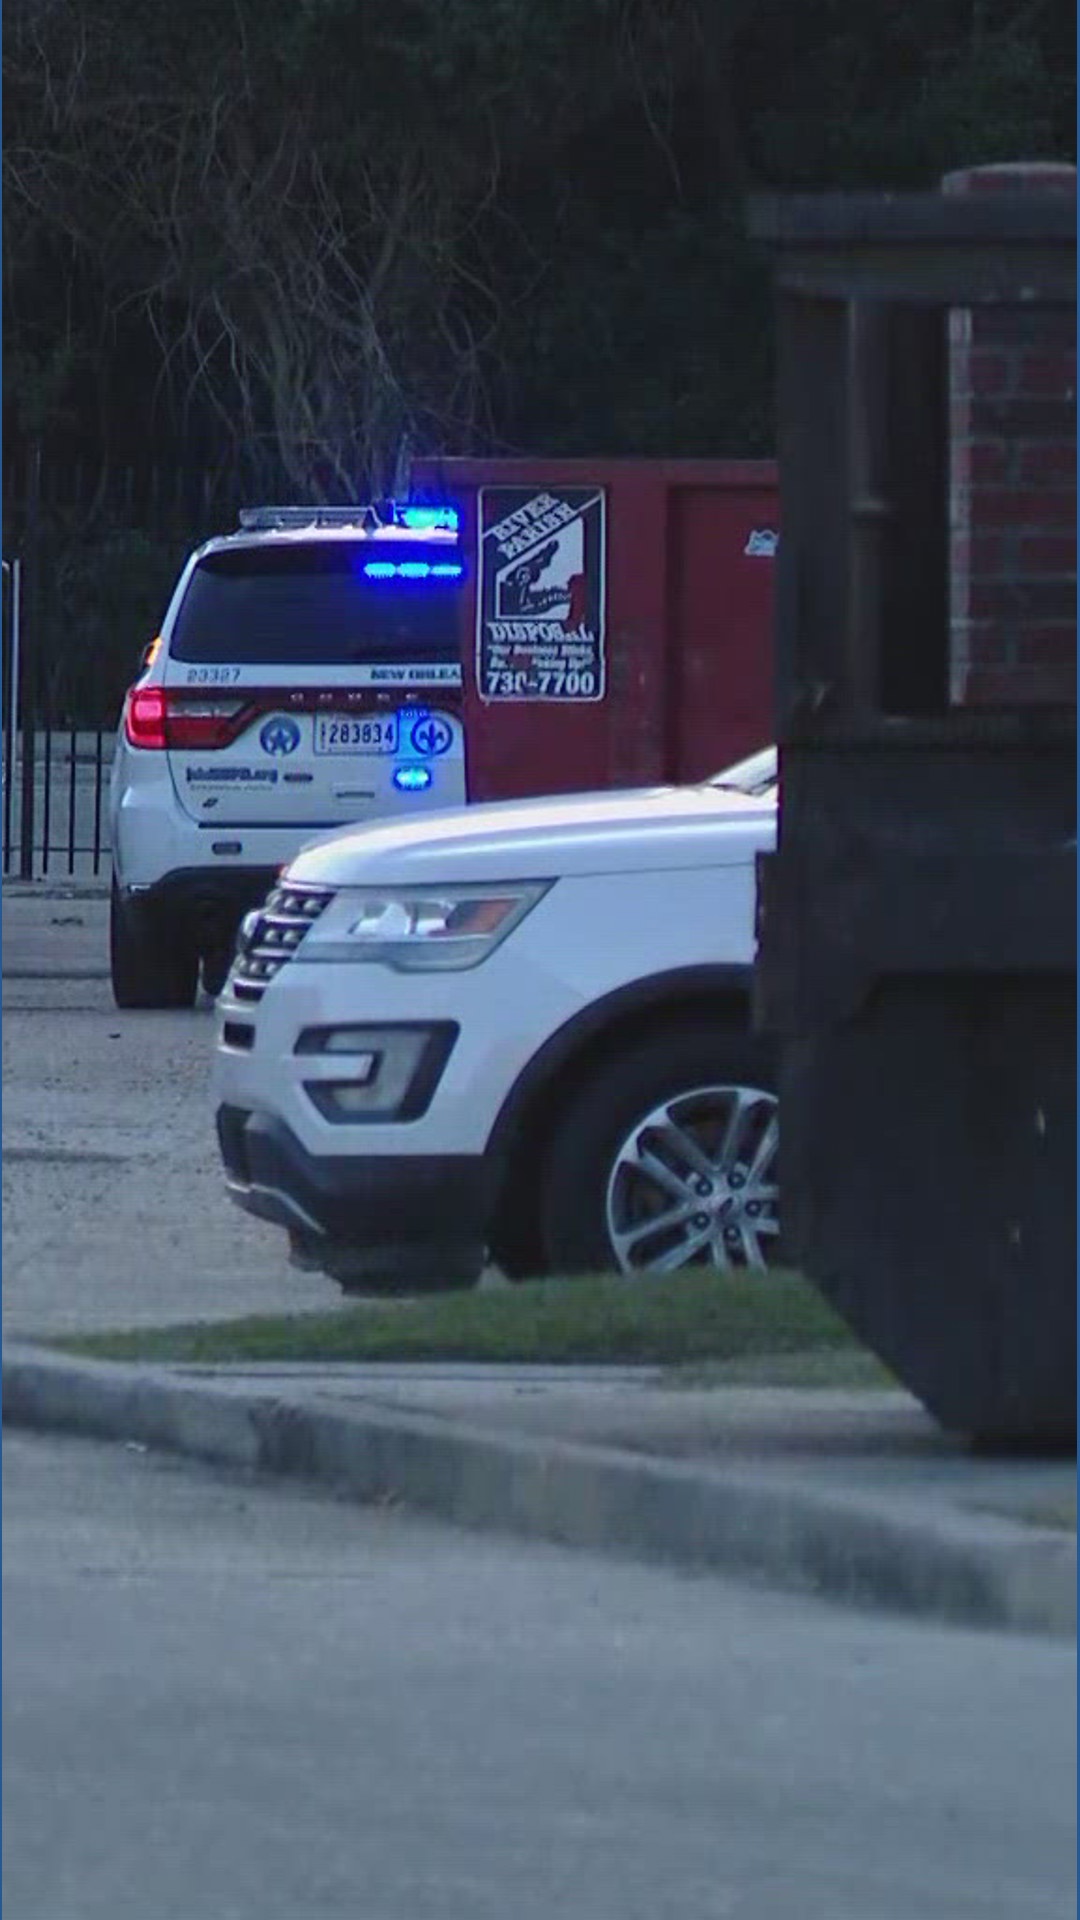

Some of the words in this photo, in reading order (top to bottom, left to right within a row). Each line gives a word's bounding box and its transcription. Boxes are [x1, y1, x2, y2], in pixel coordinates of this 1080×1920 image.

[492, 493, 560, 541] RIVER
[498, 502, 579, 560] PARISH
[371, 669, 405, 680] NEW
[486, 671, 594, 695] 730-7700
